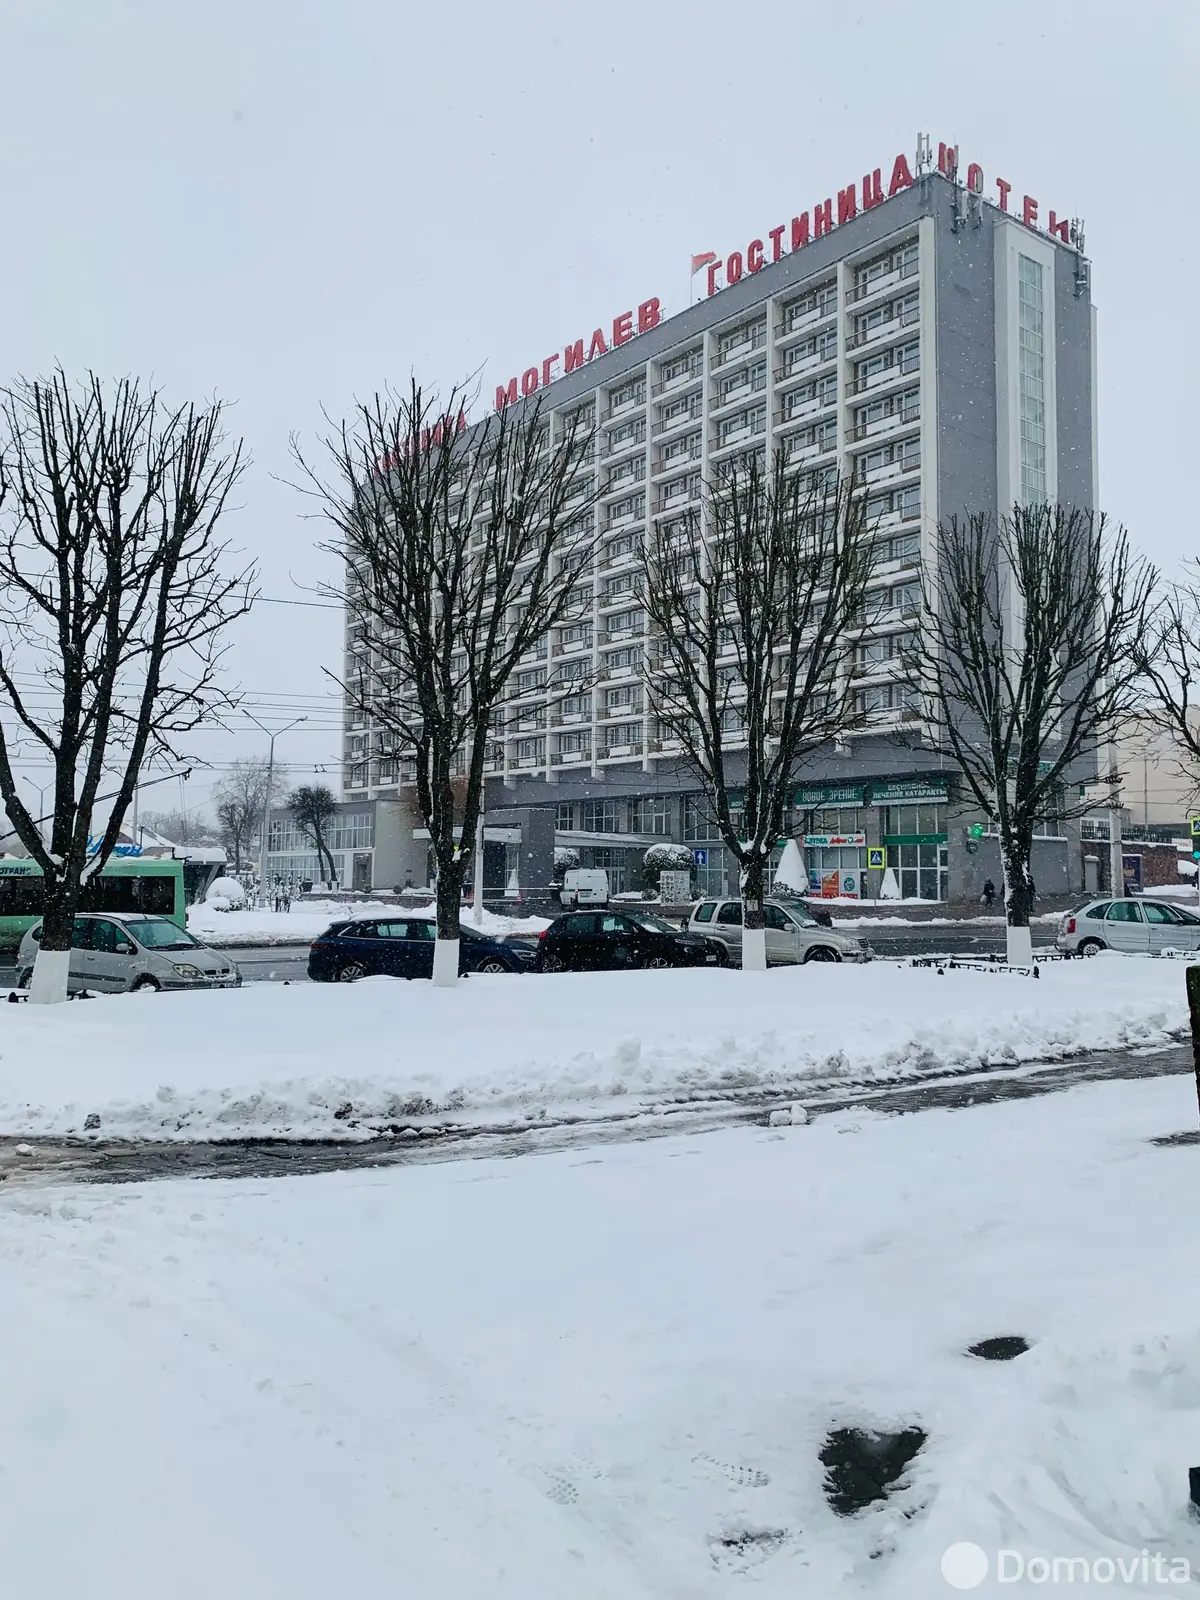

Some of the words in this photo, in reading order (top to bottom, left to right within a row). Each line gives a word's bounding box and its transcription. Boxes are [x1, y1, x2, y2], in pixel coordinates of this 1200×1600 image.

[708, 154, 914, 296] ГОСТИНИЦА
[495, 297, 660, 410] МОГИЛЕВ
[829, 789, 857, 800] ЗРЕНИЕ
[873, 790, 904, 799] ЛЕЧЕНИЕ
[905, 788, 947, 797] КАТАРАКТЫ
